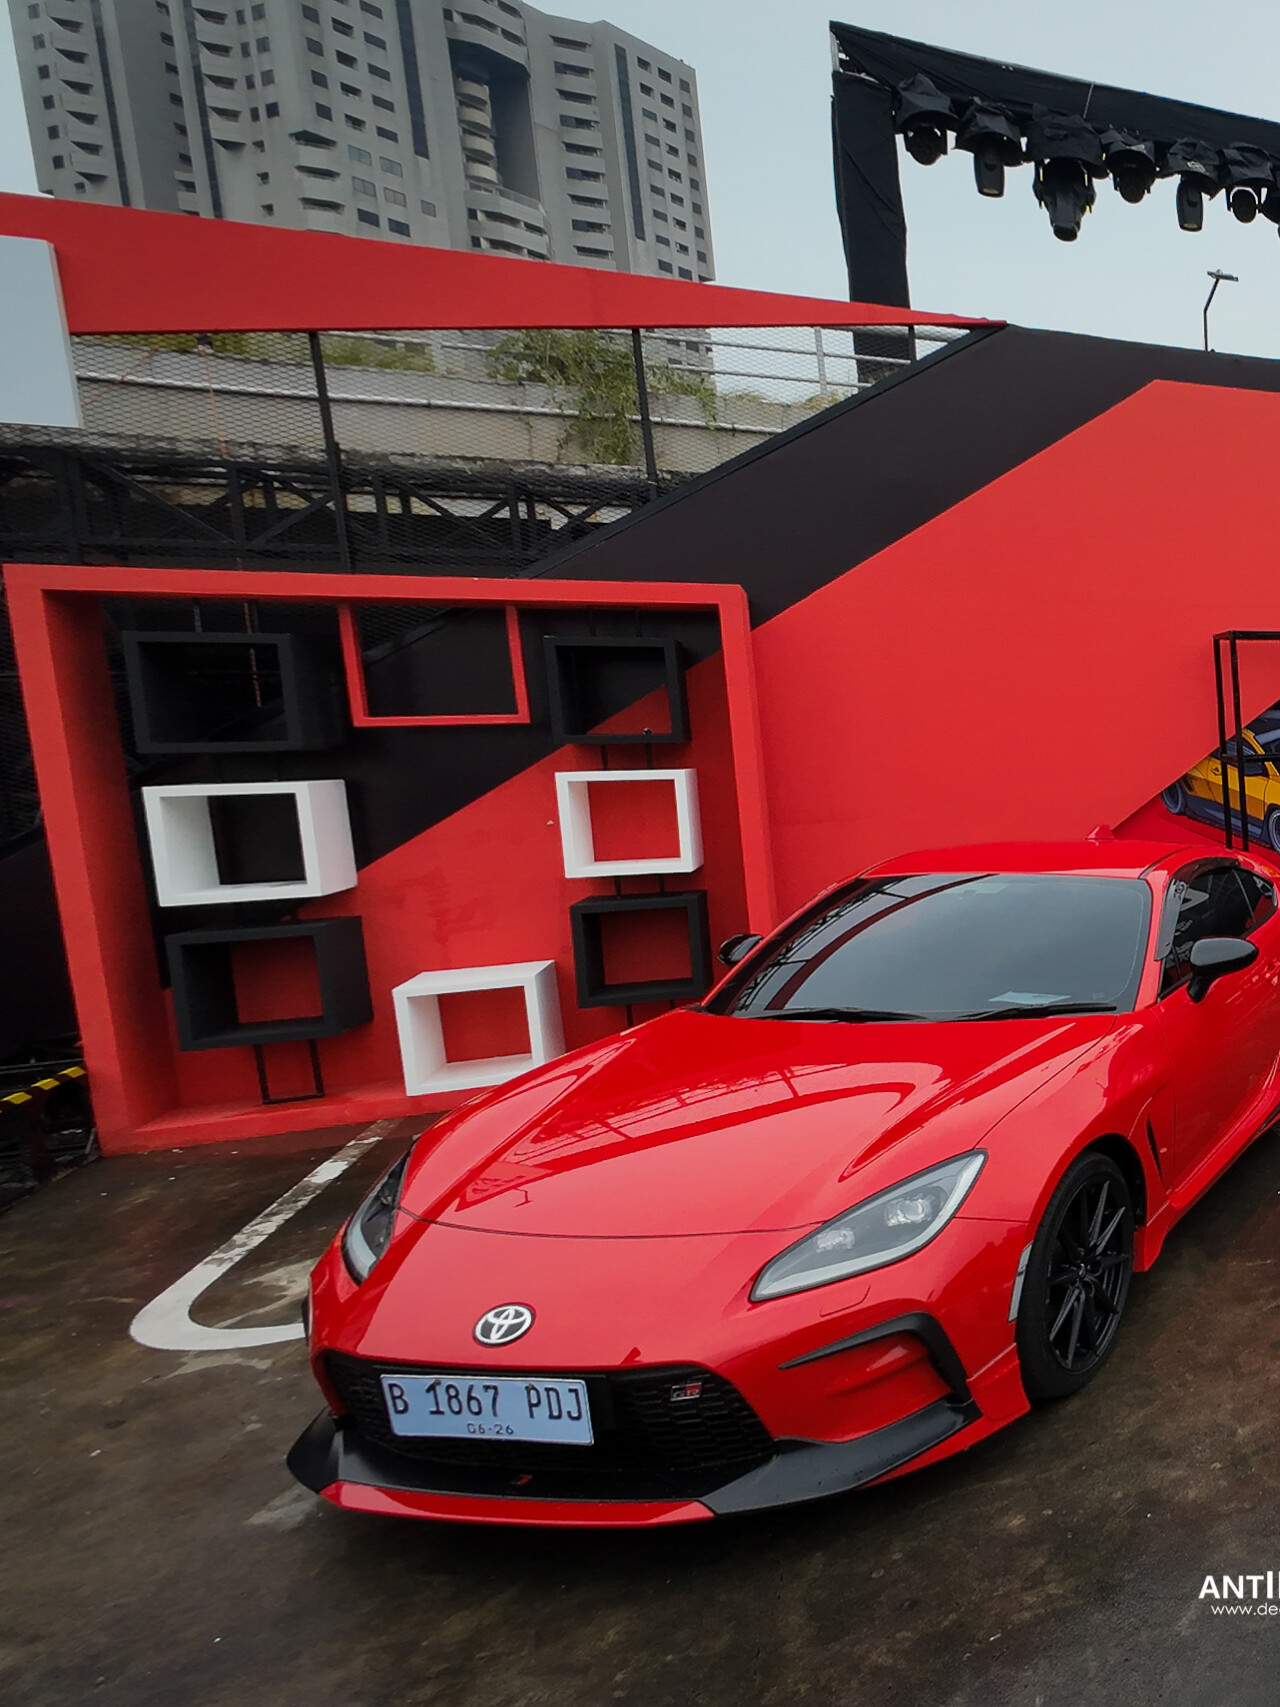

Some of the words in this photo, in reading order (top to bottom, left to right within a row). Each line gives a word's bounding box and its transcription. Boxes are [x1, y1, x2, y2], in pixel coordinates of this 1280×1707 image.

[388, 1383, 409, 1415] B
[425, 1380, 499, 1418] 1867
[524, 1383, 582, 1421] PDJ
[466, 1423, 514, 1435] 06-26
